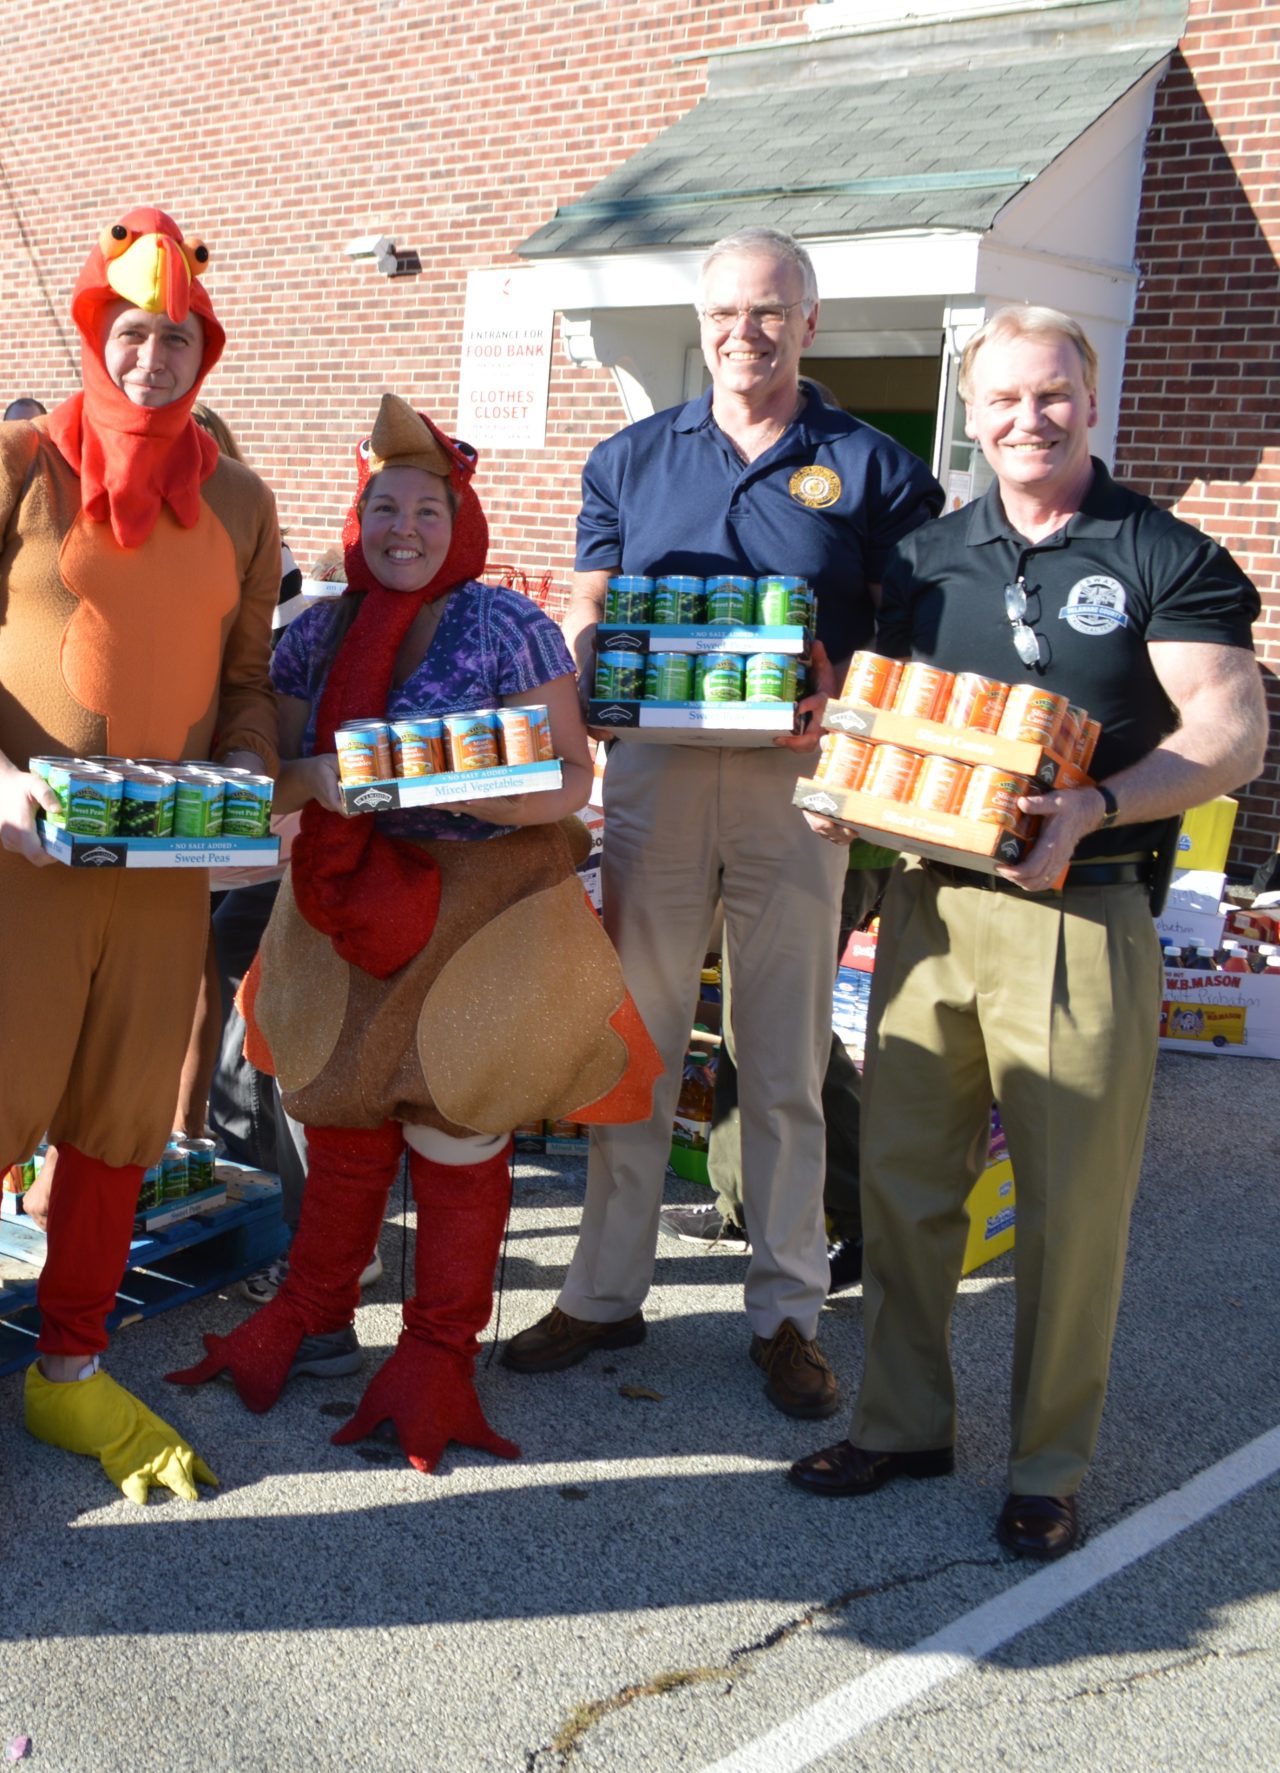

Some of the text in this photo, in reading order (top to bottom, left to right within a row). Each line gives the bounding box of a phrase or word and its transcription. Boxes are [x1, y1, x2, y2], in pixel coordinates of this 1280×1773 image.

[470, 329, 544, 340] ENTRANCE FOR
[466, 343, 545, 358] FOOD BANK
[470, 390, 535, 403] CLOTHES
[475, 406, 529, 419] CLOSET
[434, 778, 524, 797] Mixed Vegetables
[174, 852, 231, 863] Sweet Peas
